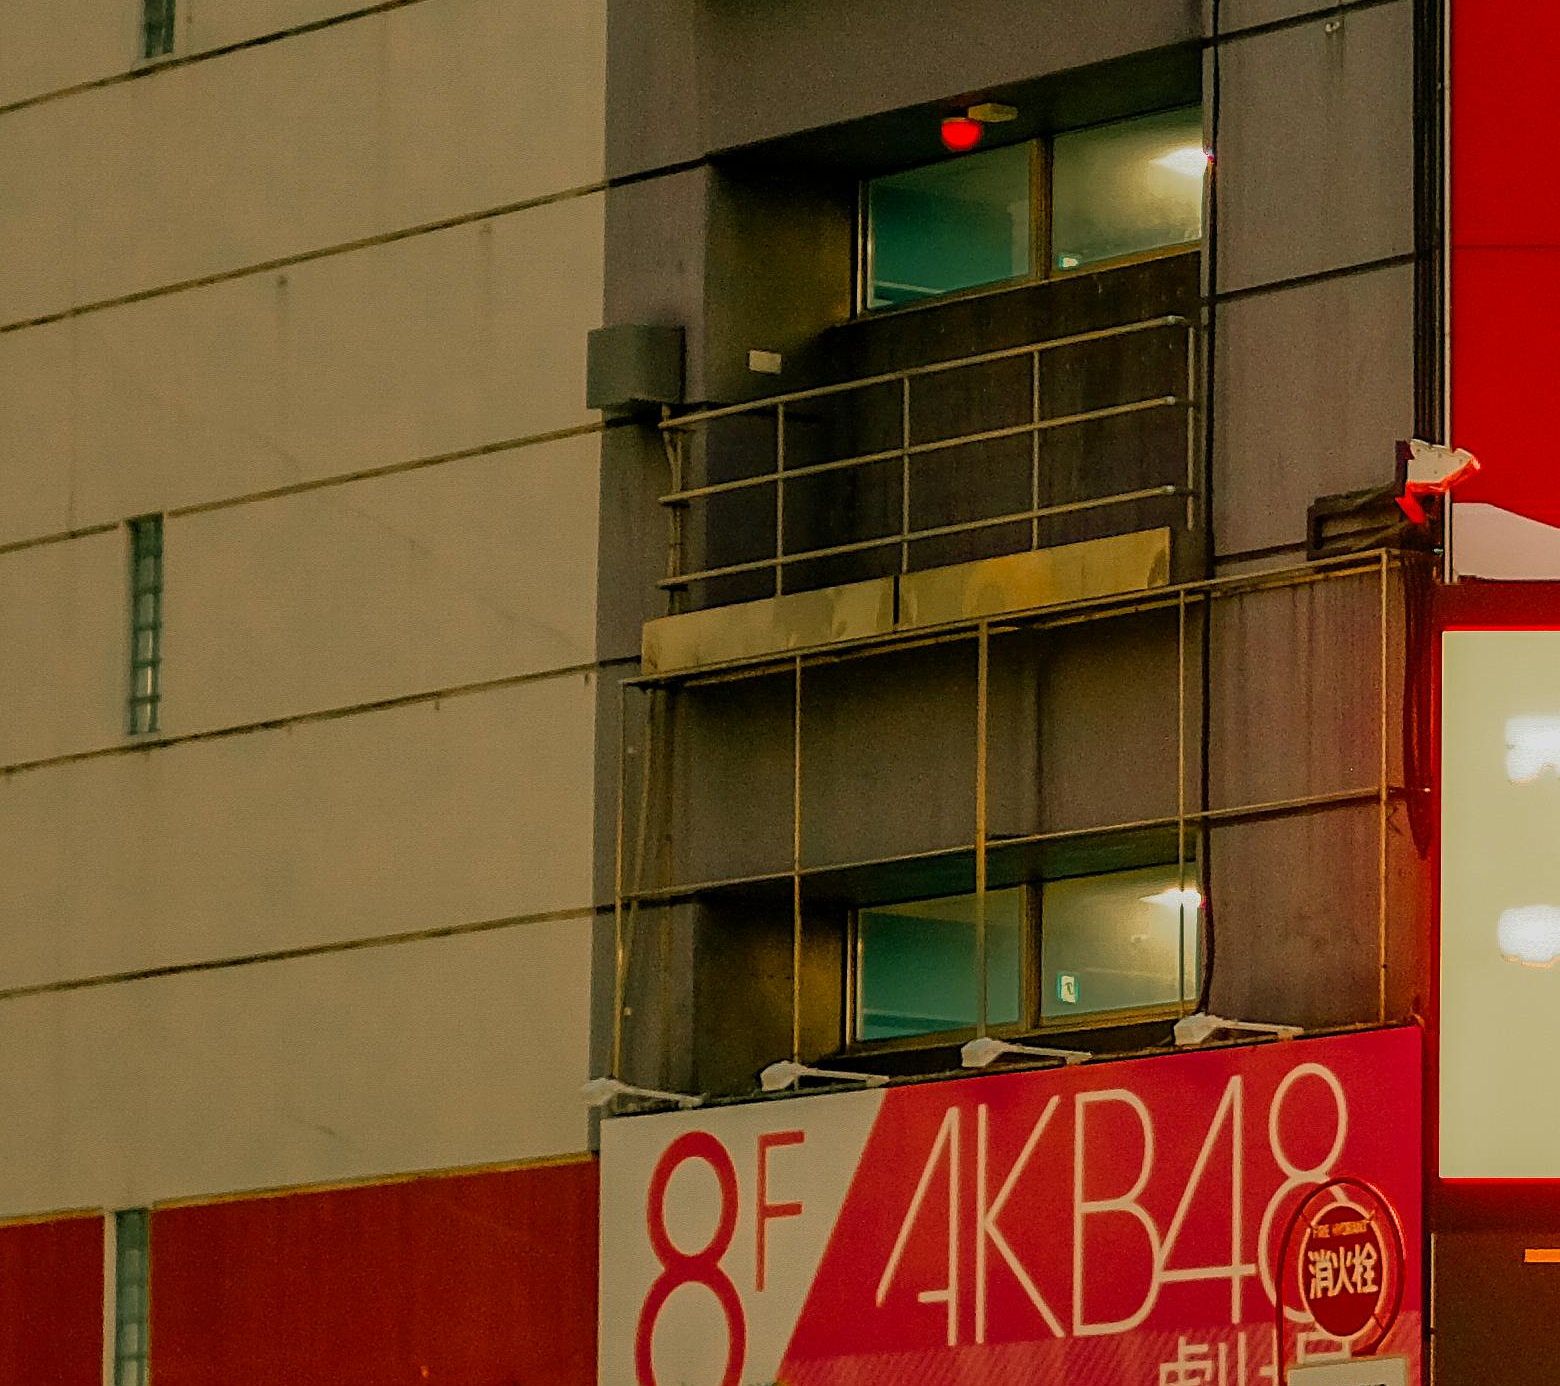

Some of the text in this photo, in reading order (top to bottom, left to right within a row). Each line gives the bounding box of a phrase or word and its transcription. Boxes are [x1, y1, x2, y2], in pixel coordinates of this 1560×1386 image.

[876, 1062, 1355, 1345] AKB48
[1308, 1242, 1379, 1299] 消火栓
